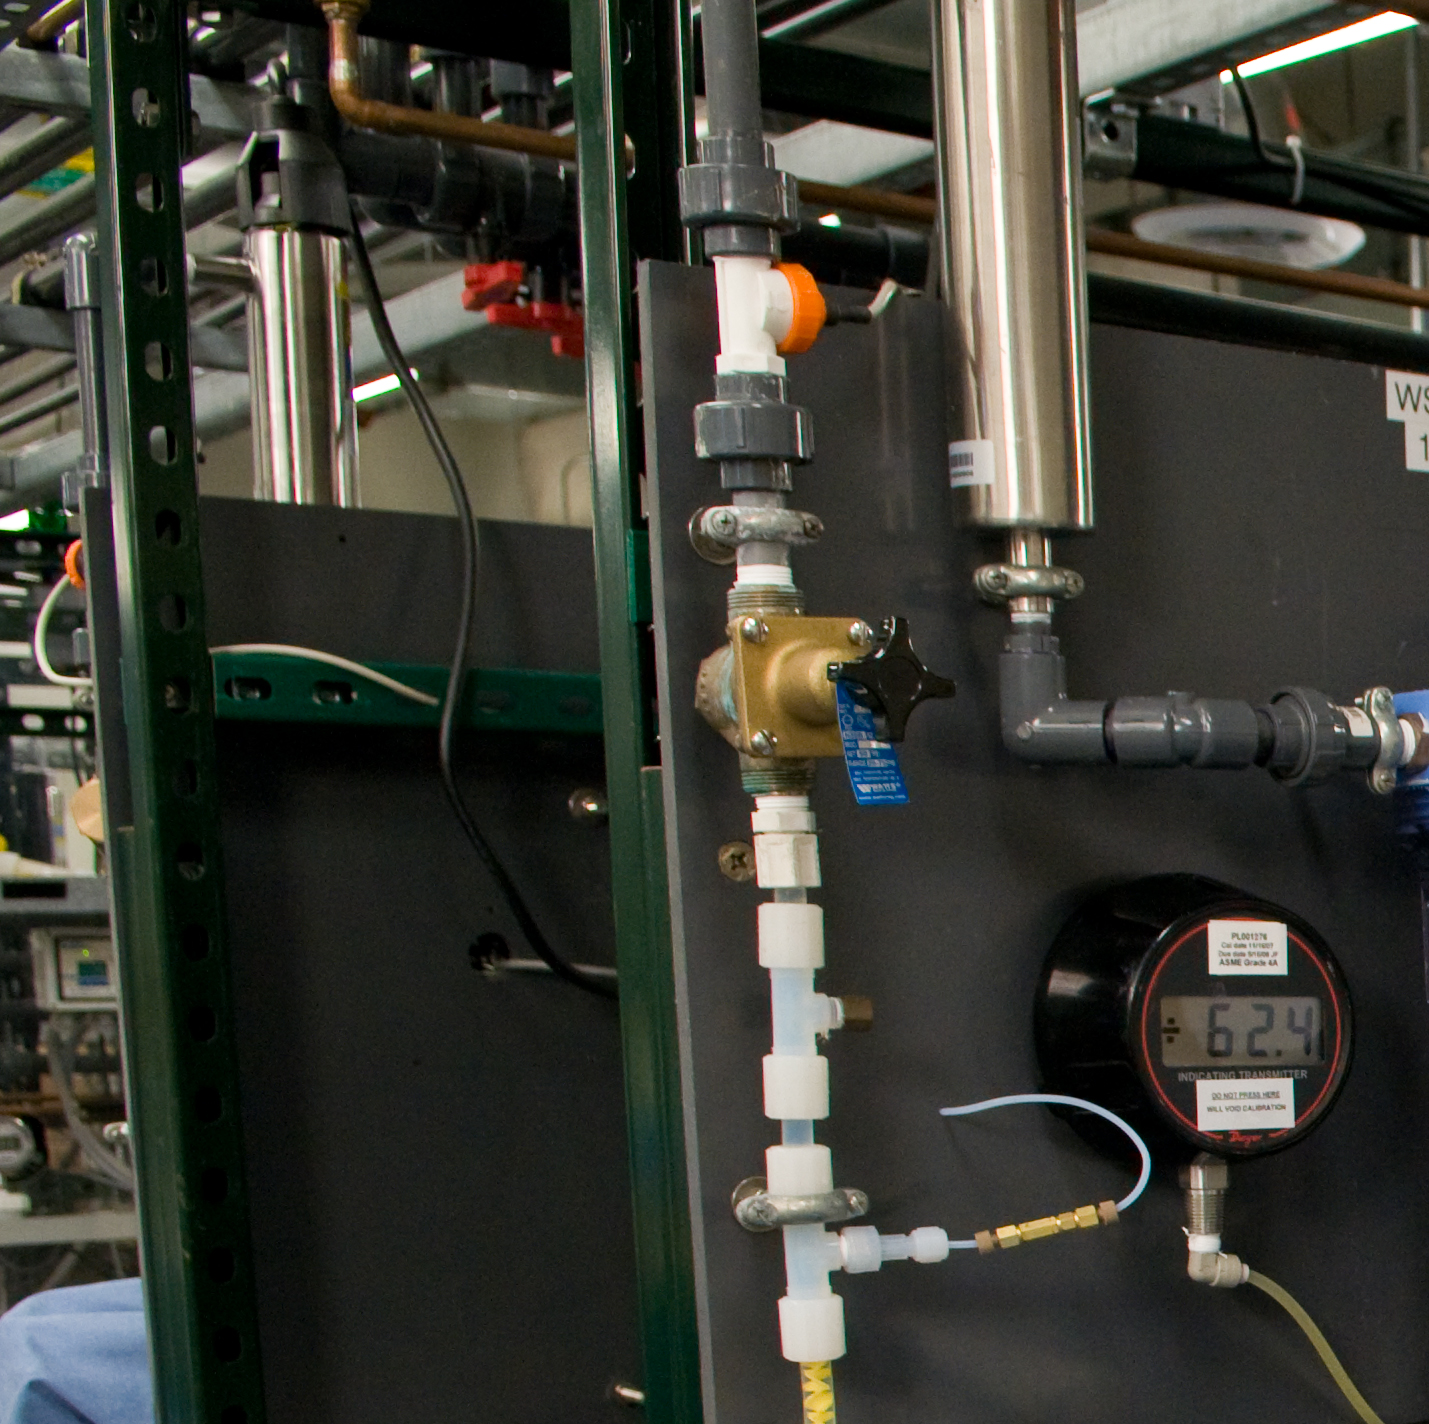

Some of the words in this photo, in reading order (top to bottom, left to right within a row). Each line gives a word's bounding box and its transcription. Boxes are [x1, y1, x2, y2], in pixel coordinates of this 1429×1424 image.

[1419, 433, 1429, 461] 1
[1219, 958, 1242, 966] ASME
[1206, 1003, 1314, 1058] 62.4
[1178, 1070, 1236, 1082] INDICATING
[1239, 1069, 1308, 1080] TRANSMITTER
[1223, 1091, 1237, 1100] NOT
[1262, 1090, 1281, 1099] HERE
